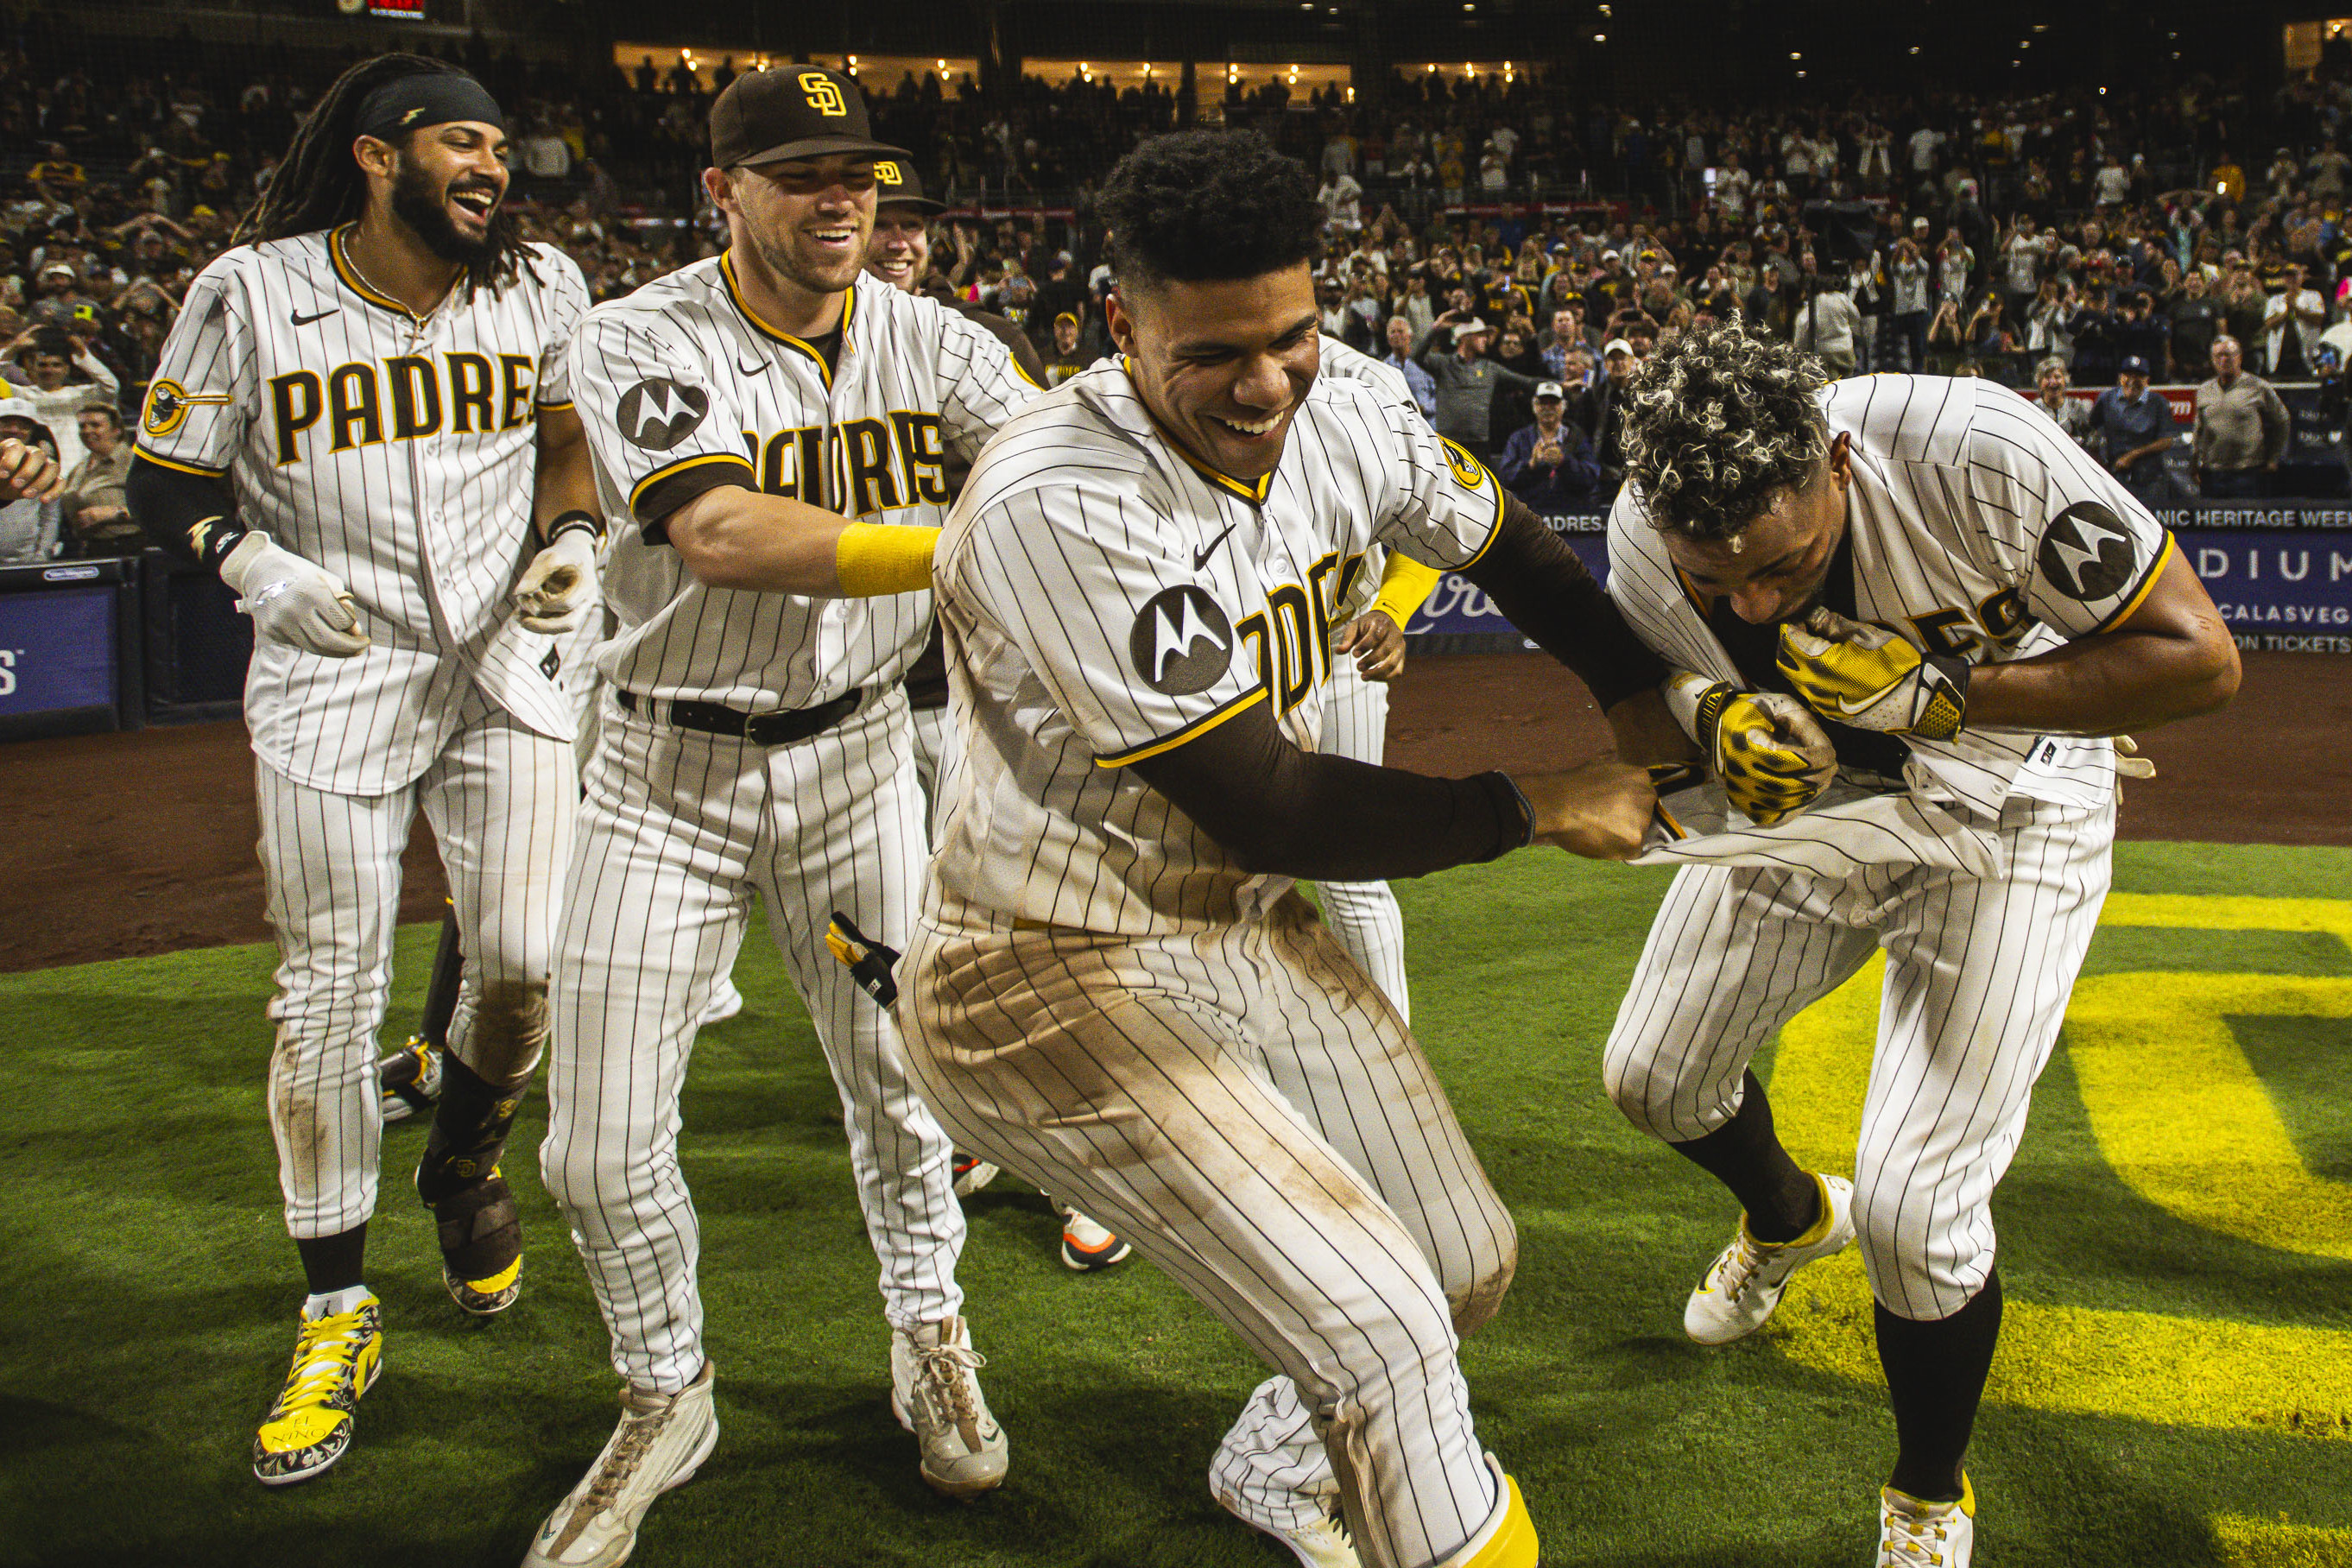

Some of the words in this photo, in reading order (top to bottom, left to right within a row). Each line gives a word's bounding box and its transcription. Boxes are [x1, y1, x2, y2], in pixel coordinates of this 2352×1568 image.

[798, 73, 847, 117] SD
[267, 352, 534, 468] PADRE
[741, 409, 951, 519] ADRES
[2155, 509, 2191, 527] NIC
[2196, 509, 2297, 528] HERITAGE
[2198, 547, 2352, 582] DIUM
[2266, 635, 2351, 654] TICKETS
